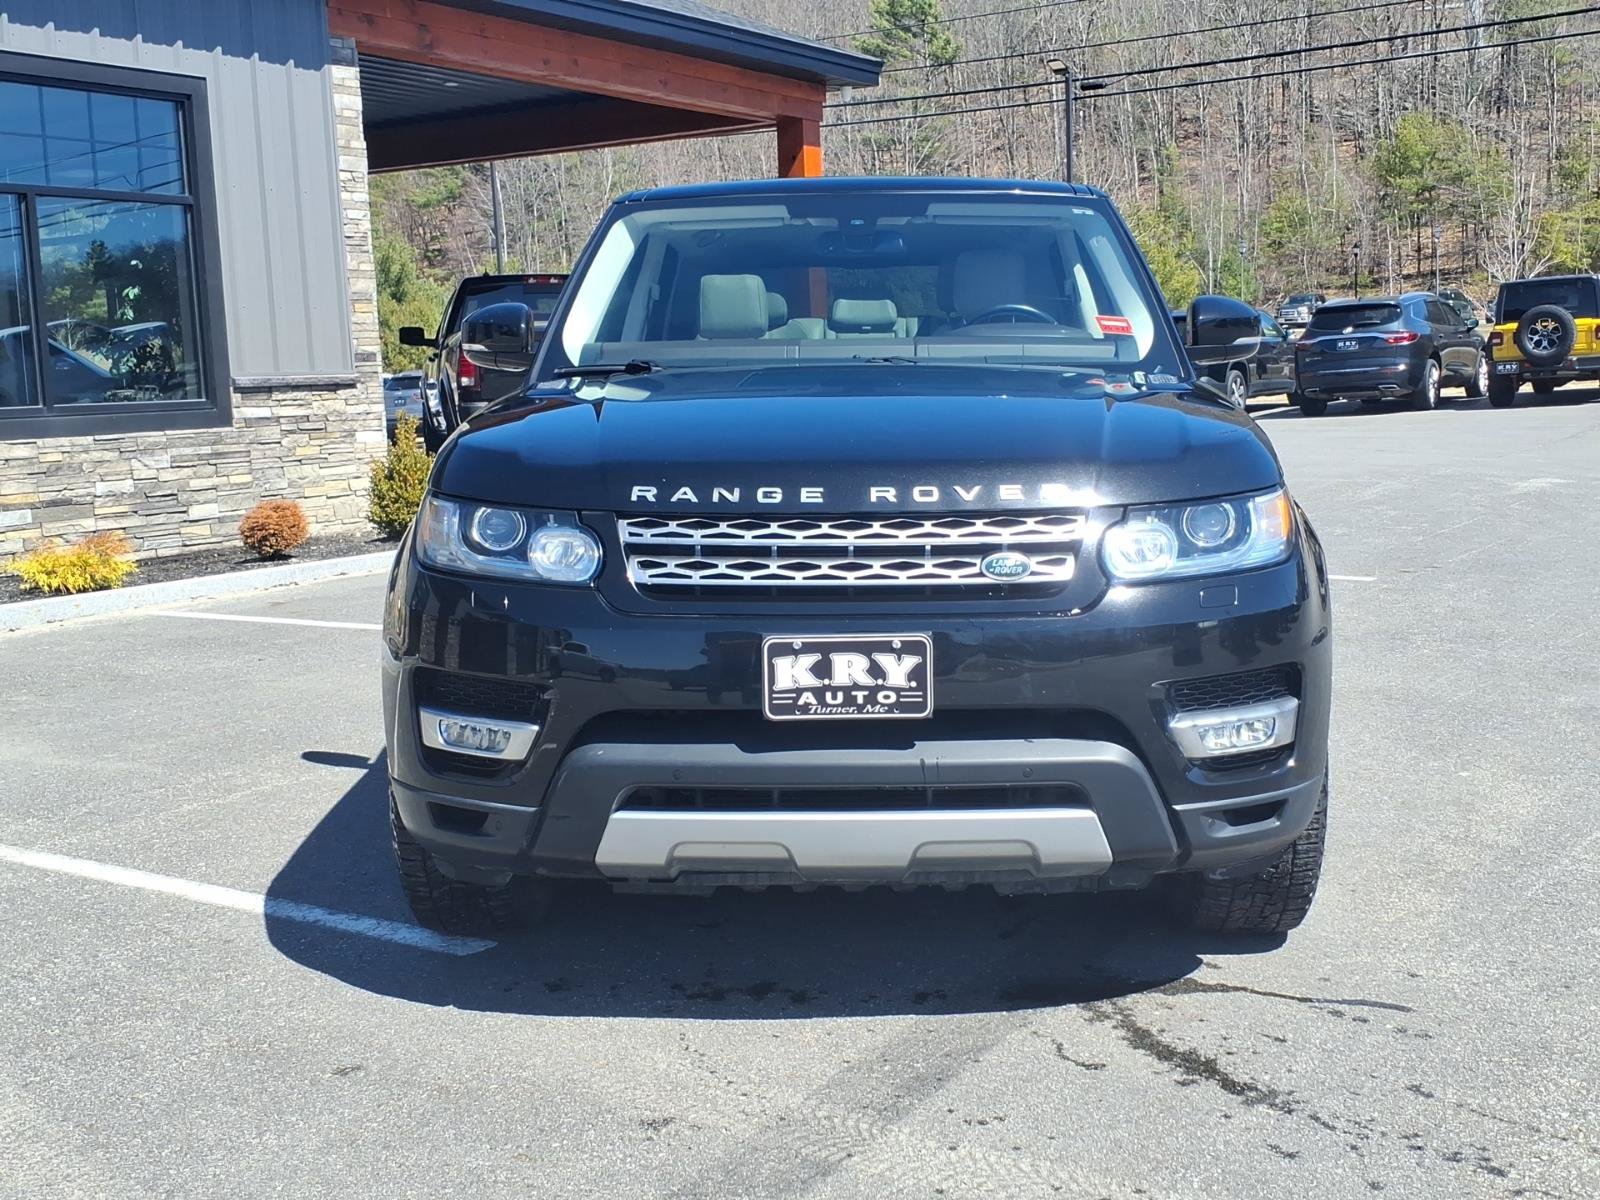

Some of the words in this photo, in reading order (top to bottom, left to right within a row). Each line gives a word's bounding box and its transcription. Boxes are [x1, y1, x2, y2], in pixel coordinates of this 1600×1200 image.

[630, 485, 825, 503] RANGE
[994, 566, 1023, 574] ROVER
[772, 653, 922, 691] K.R.Y.
[797, 690, 898, 705] AUTO
[863, 704, 889, 713] Me
